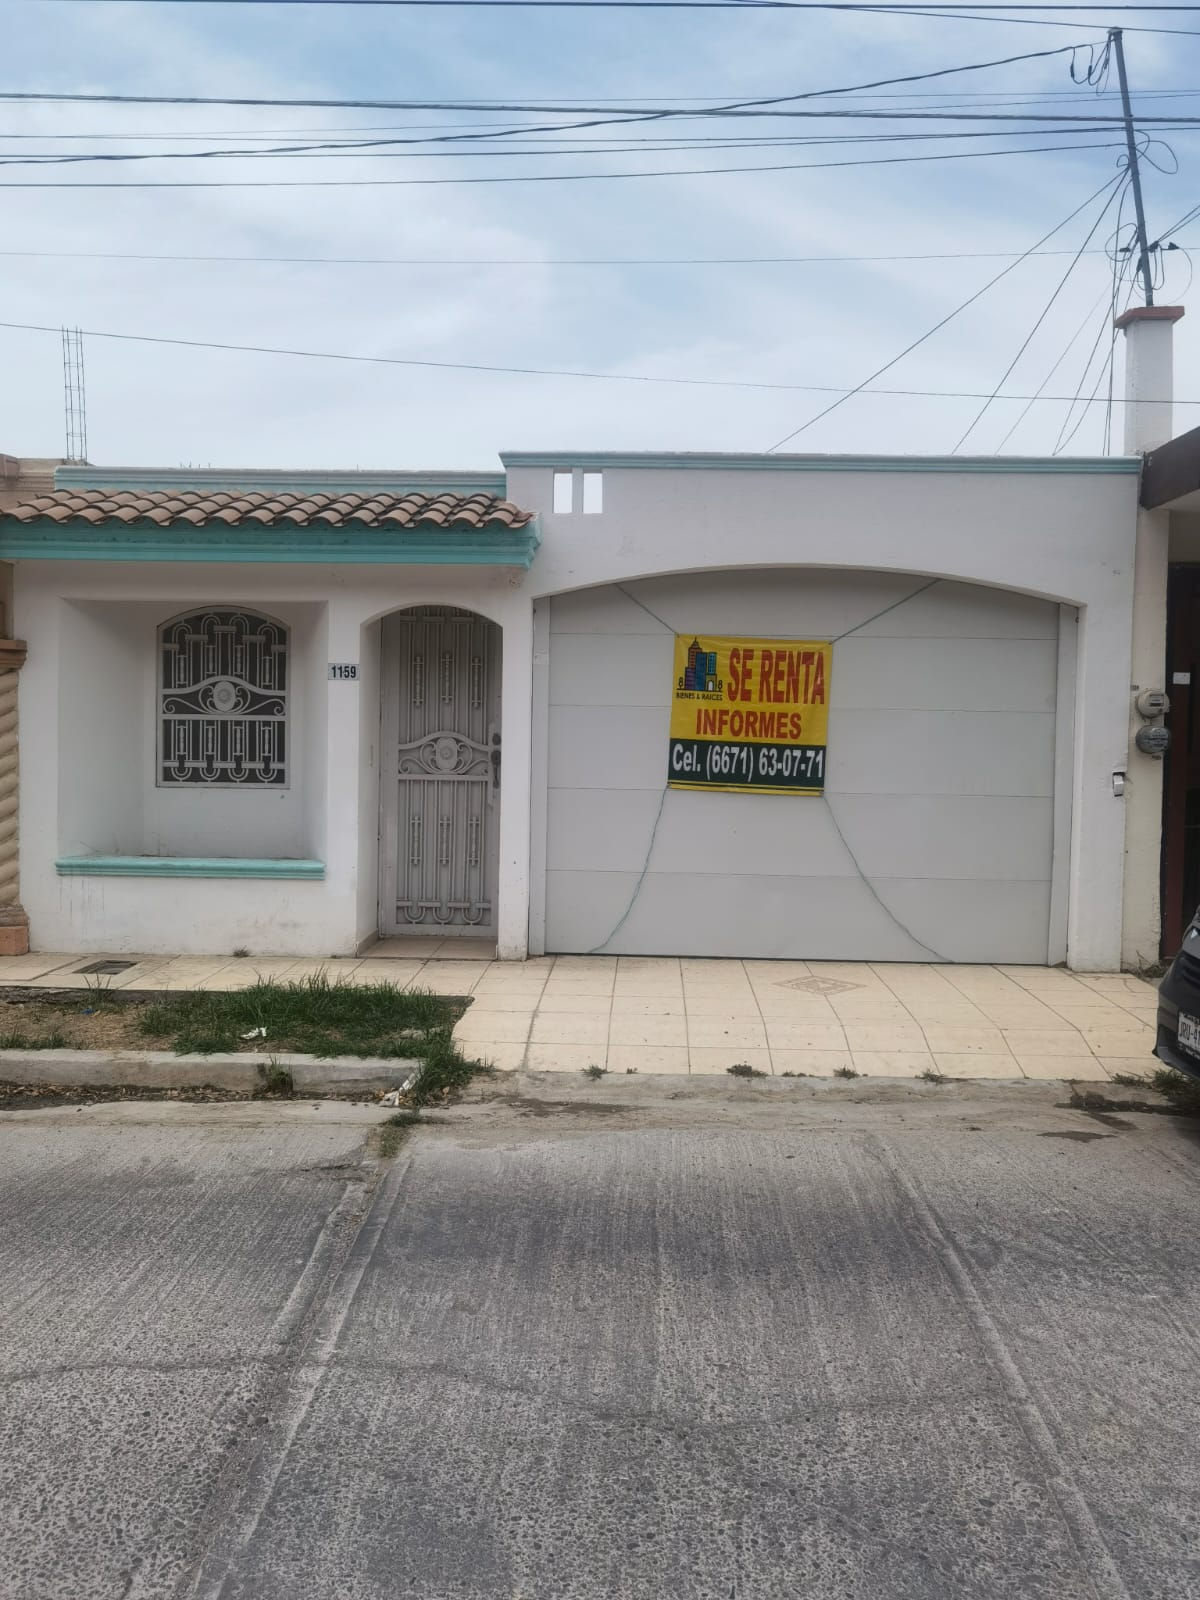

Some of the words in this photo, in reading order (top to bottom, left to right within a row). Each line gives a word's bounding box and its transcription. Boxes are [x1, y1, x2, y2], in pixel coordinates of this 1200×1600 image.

[331, 665, 356, 678] 1159
[727, 648, 754, 703] SE
[758, 649, 825, 705] RENTA
[676, 692, 695, 700] BIENES
[695, 708, 802, 740] INFORMES
[672, 743, 701, 772] Cel.
[706, 745, 754, 782] (6671)
[758, 748, 824, 778] 63-07-71
